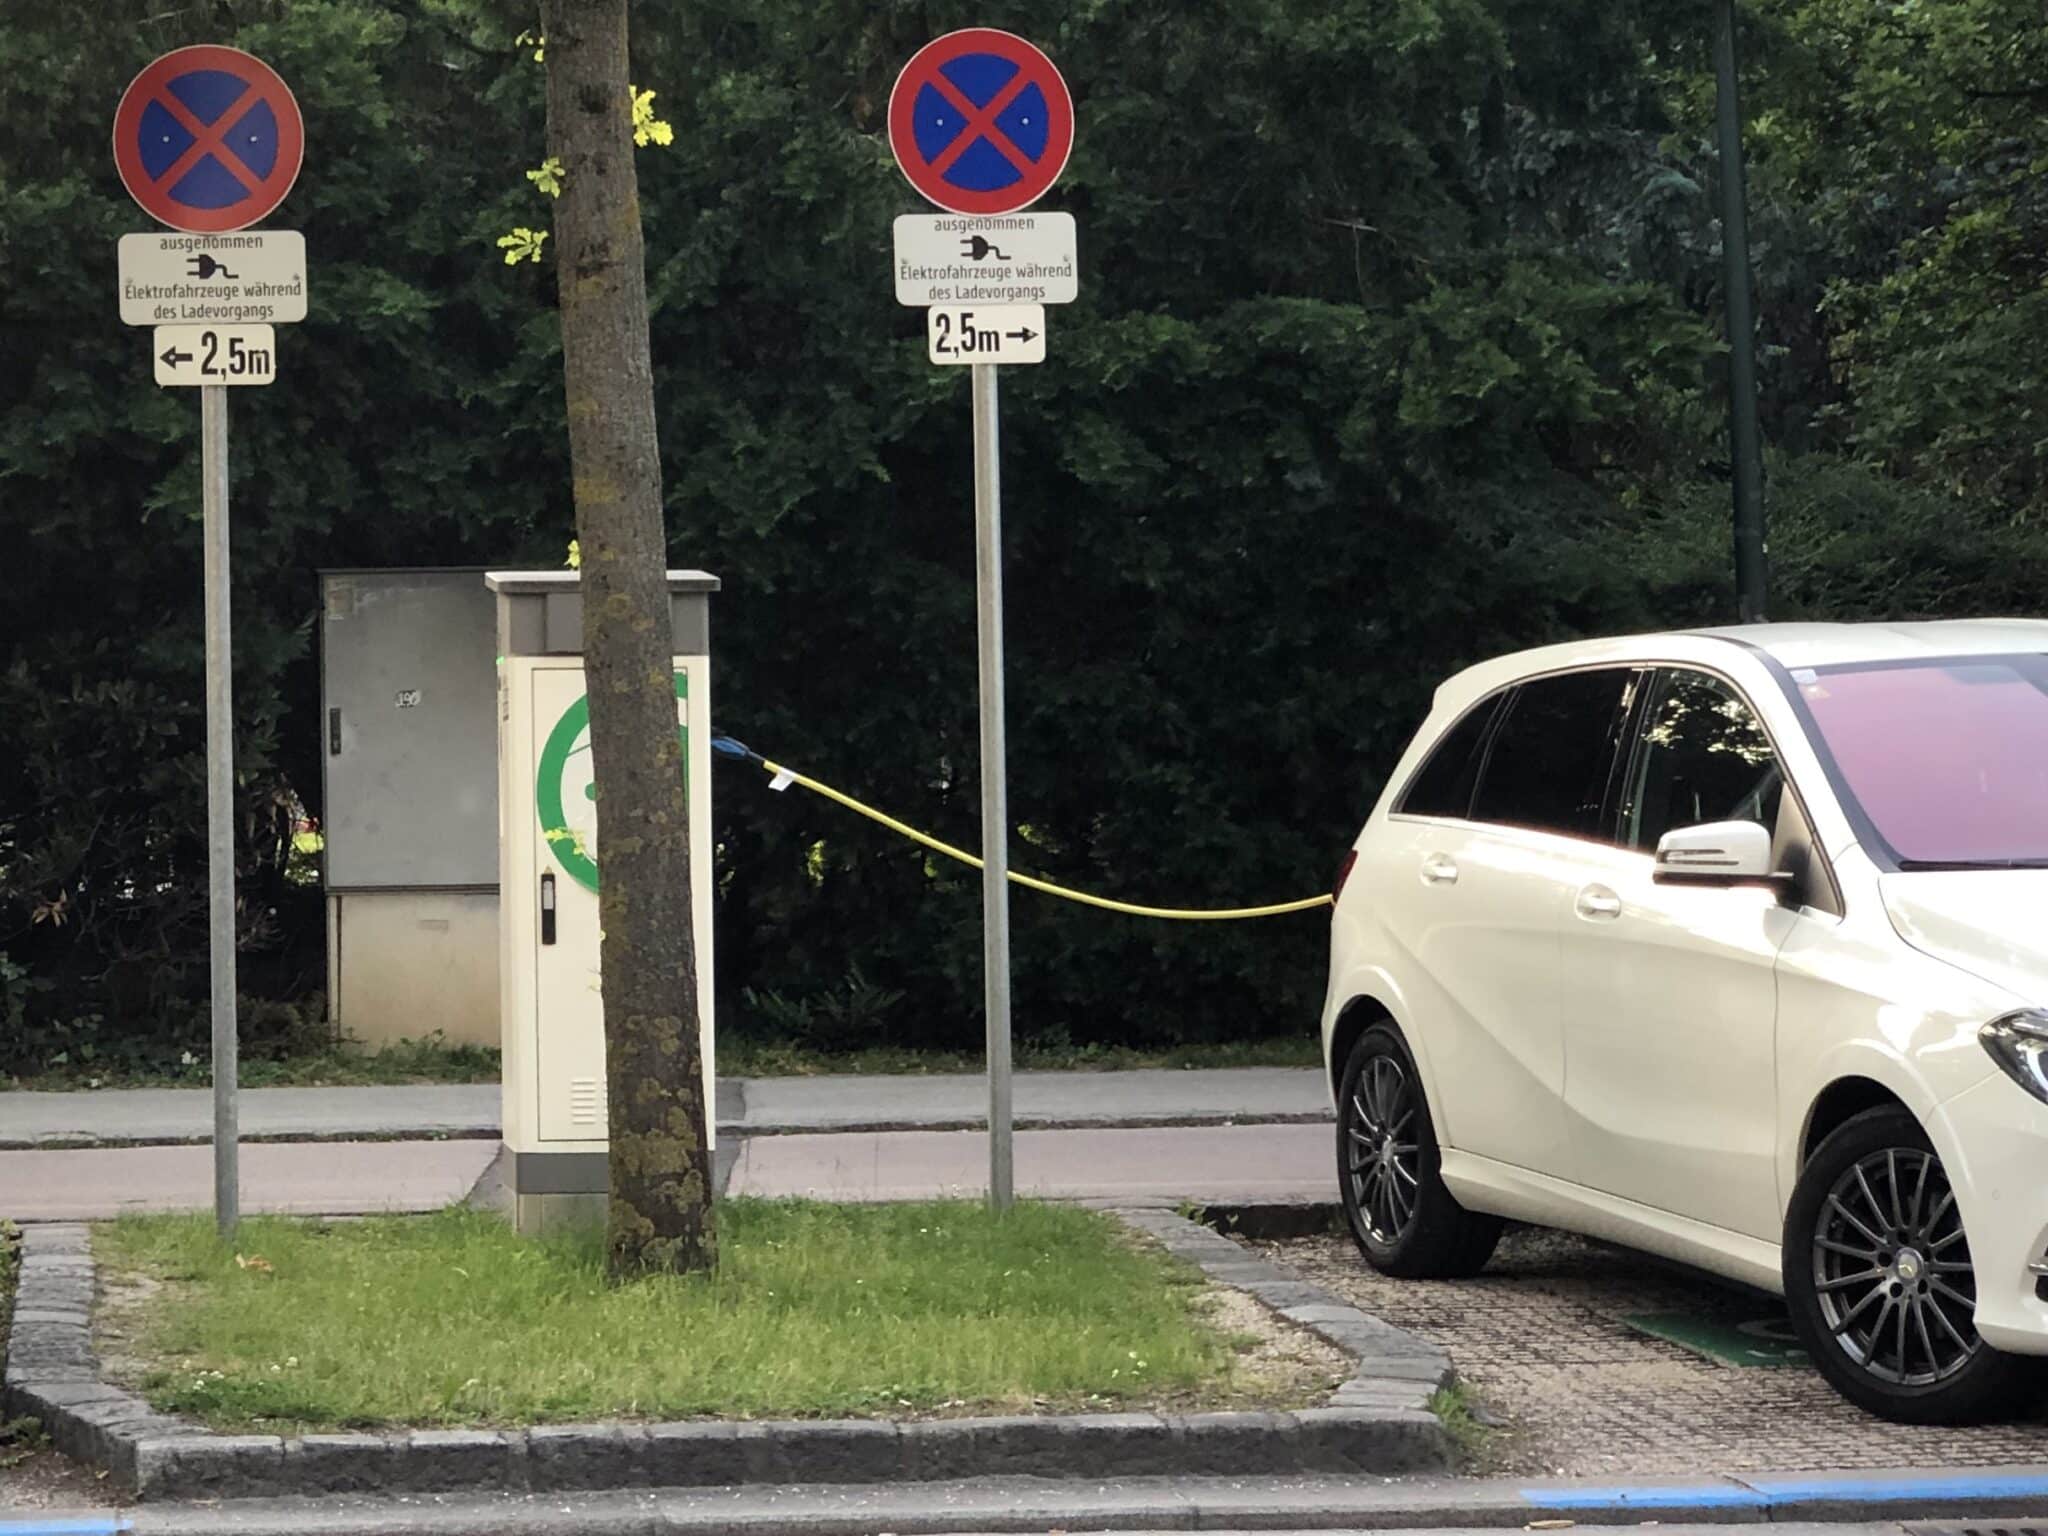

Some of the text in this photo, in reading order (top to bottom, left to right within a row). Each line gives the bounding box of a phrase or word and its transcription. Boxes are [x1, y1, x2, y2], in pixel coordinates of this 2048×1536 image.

[934, 218, 1035, 234] ausgenommen
[160, 236, 263, 252] ausgenommen
[900, 262, 1072, 281] Elektrofahrzeuge während
[125, 281, 301, 300] Elektrofahrzeuge während
[929, 285, 1046, 301] des Ladevorgangs
[154, 304, 274, 320] des Ladevorgangs
